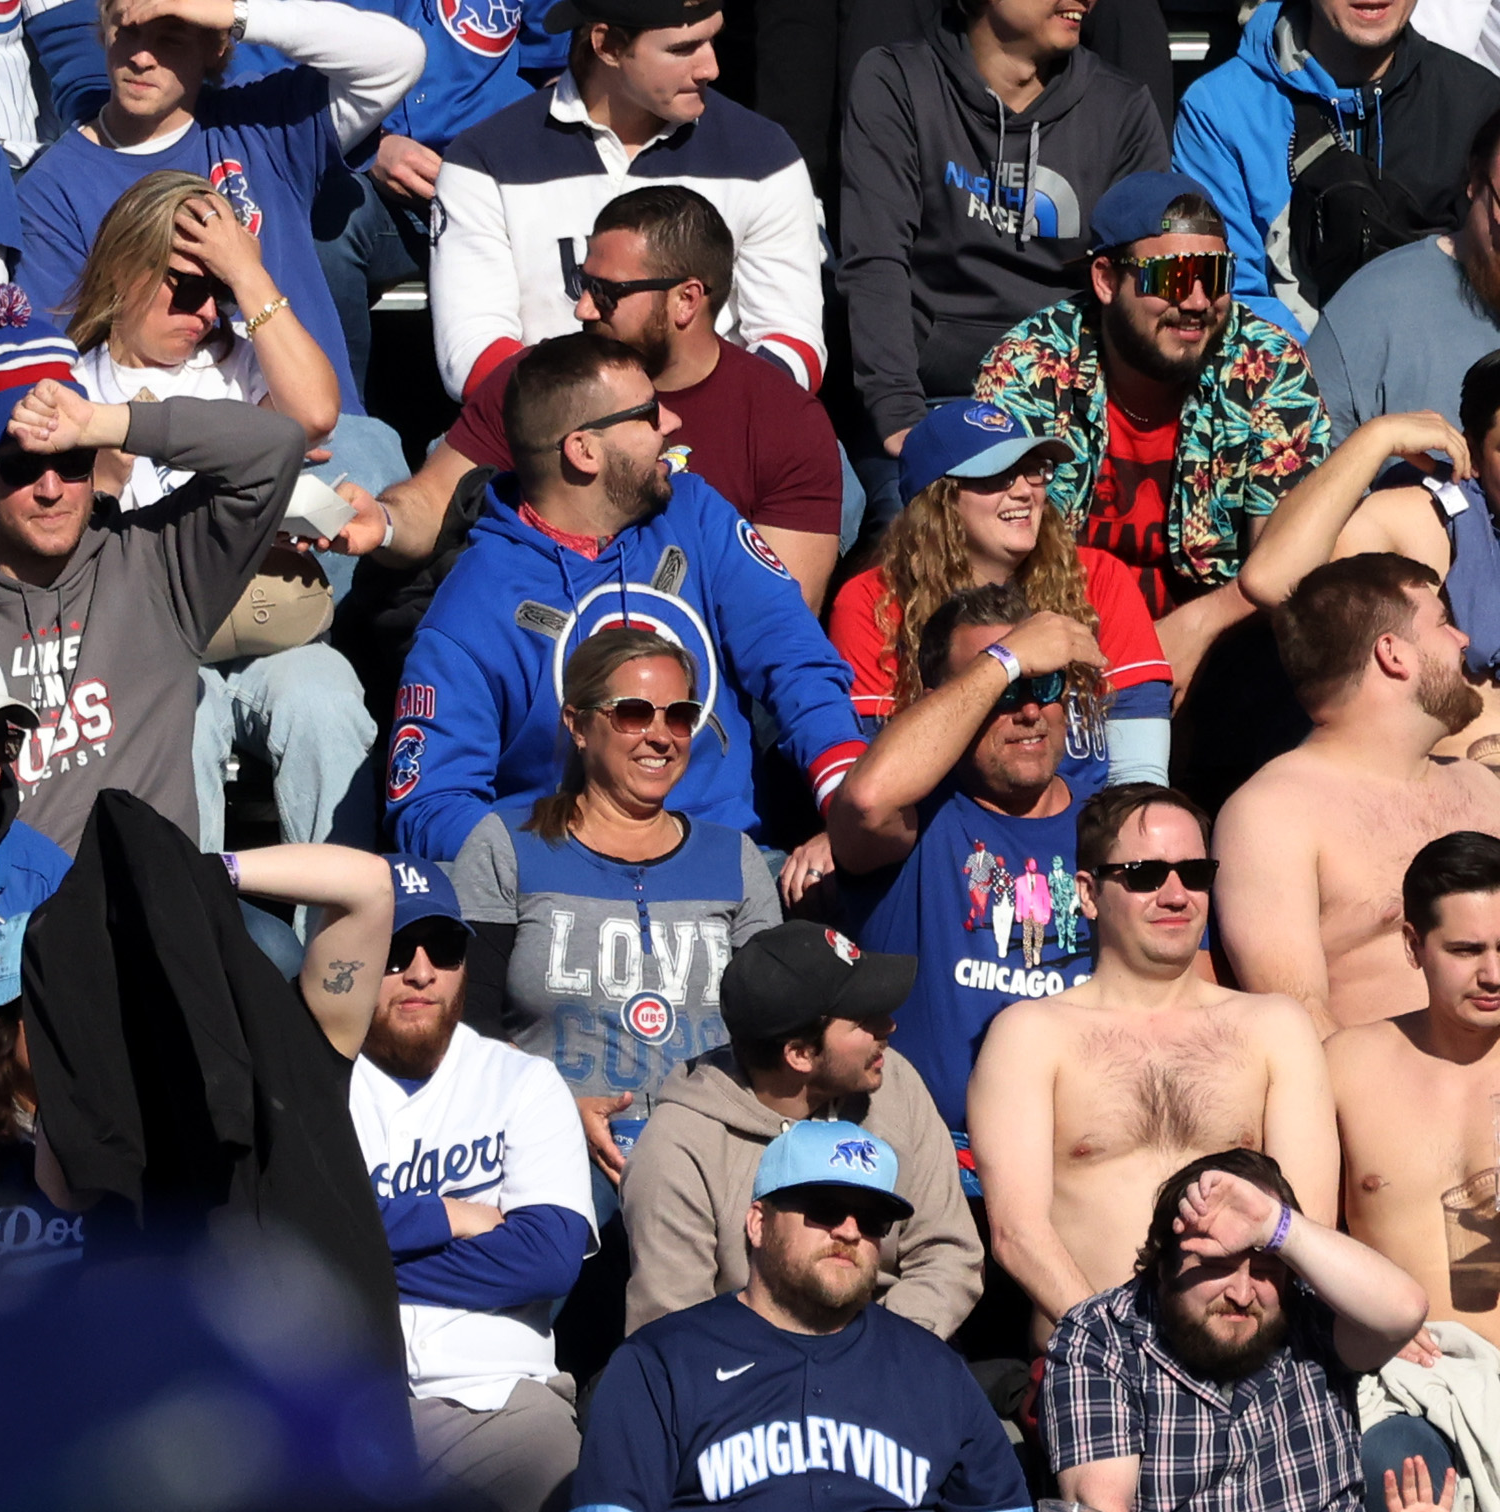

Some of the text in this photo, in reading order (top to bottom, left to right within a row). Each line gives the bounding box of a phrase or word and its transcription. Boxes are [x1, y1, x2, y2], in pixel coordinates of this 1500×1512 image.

[393, 863, 430, 894] LA
[954, 958, 1062, 999] CHICAGO
[633, 1000, 667, 1036] CUBS
[366, 1135, 506, 1205] odgers
[696, 1416, 932, 1508] WRIGLEYVILLE
